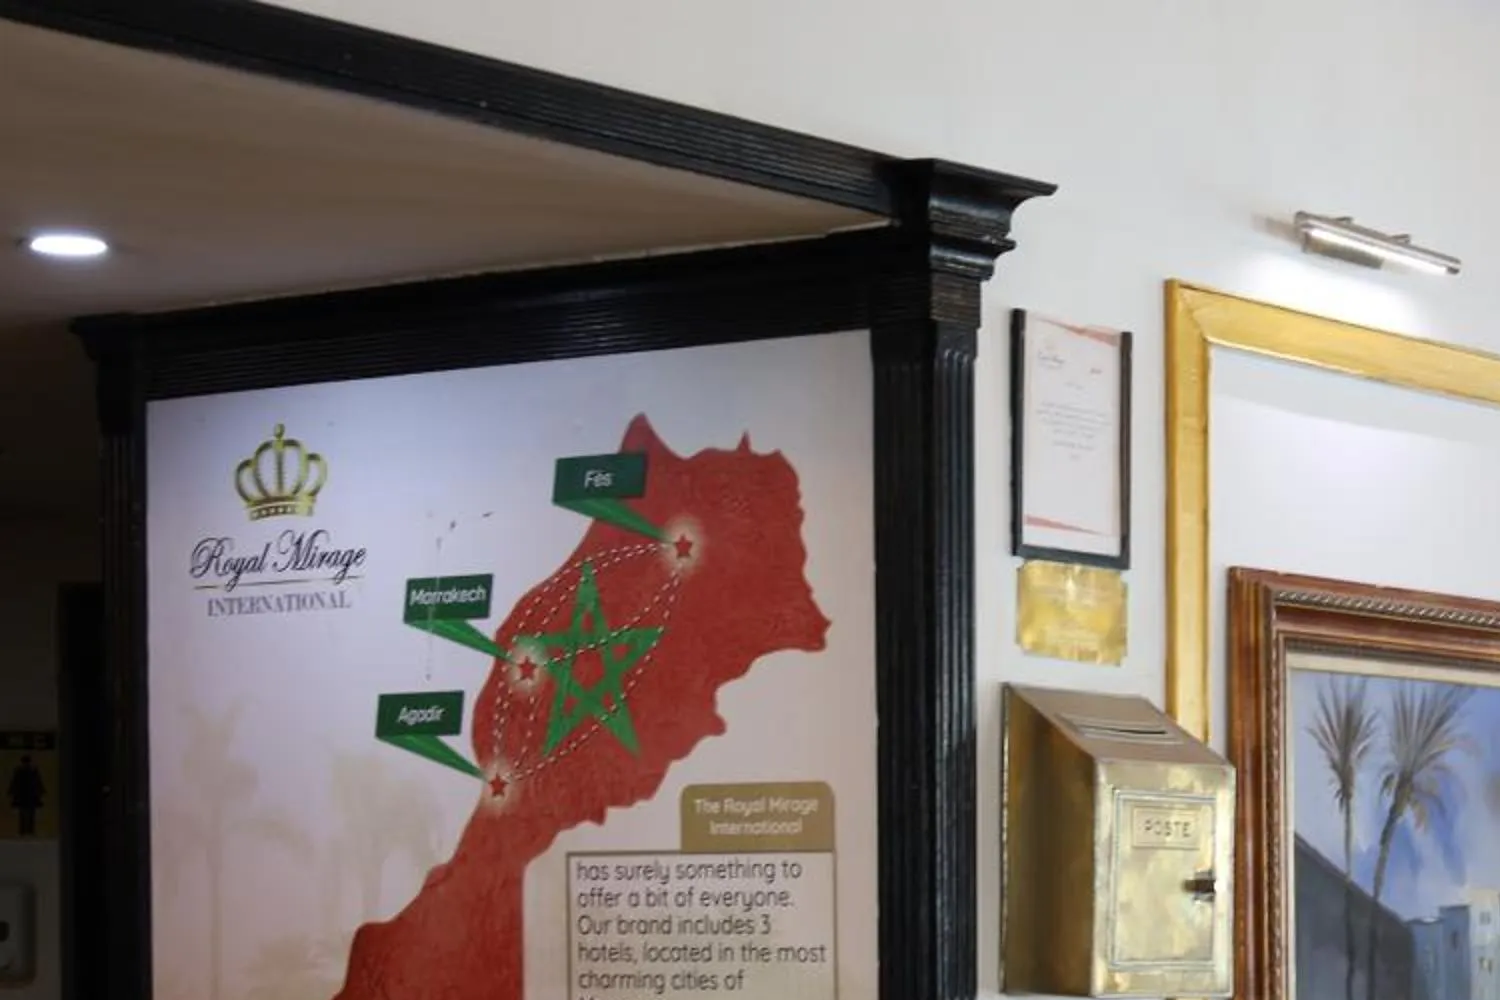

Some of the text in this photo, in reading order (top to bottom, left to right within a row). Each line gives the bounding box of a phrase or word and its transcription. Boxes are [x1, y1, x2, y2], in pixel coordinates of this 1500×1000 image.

[189, 529, 367, 592] Royal Mirage
[208, 590, 352, 618] INTERNATIONAL
[410, 585, 488, 607] Marrakech
[398, 705, 445, 726] Agadir
[694, 798, 818, 816] The Royal Mirage
[710, 818, 802, 835] International
[577, 860, 803, 884] has surely something to
[577, 888, 794, 911] offer a bit of everyone.
[577, 915, 772, 935] Our brand includes 3
[577, 943, 827, 965] hotels, located in the most
[578, 970, 744, 995] charming cities of
